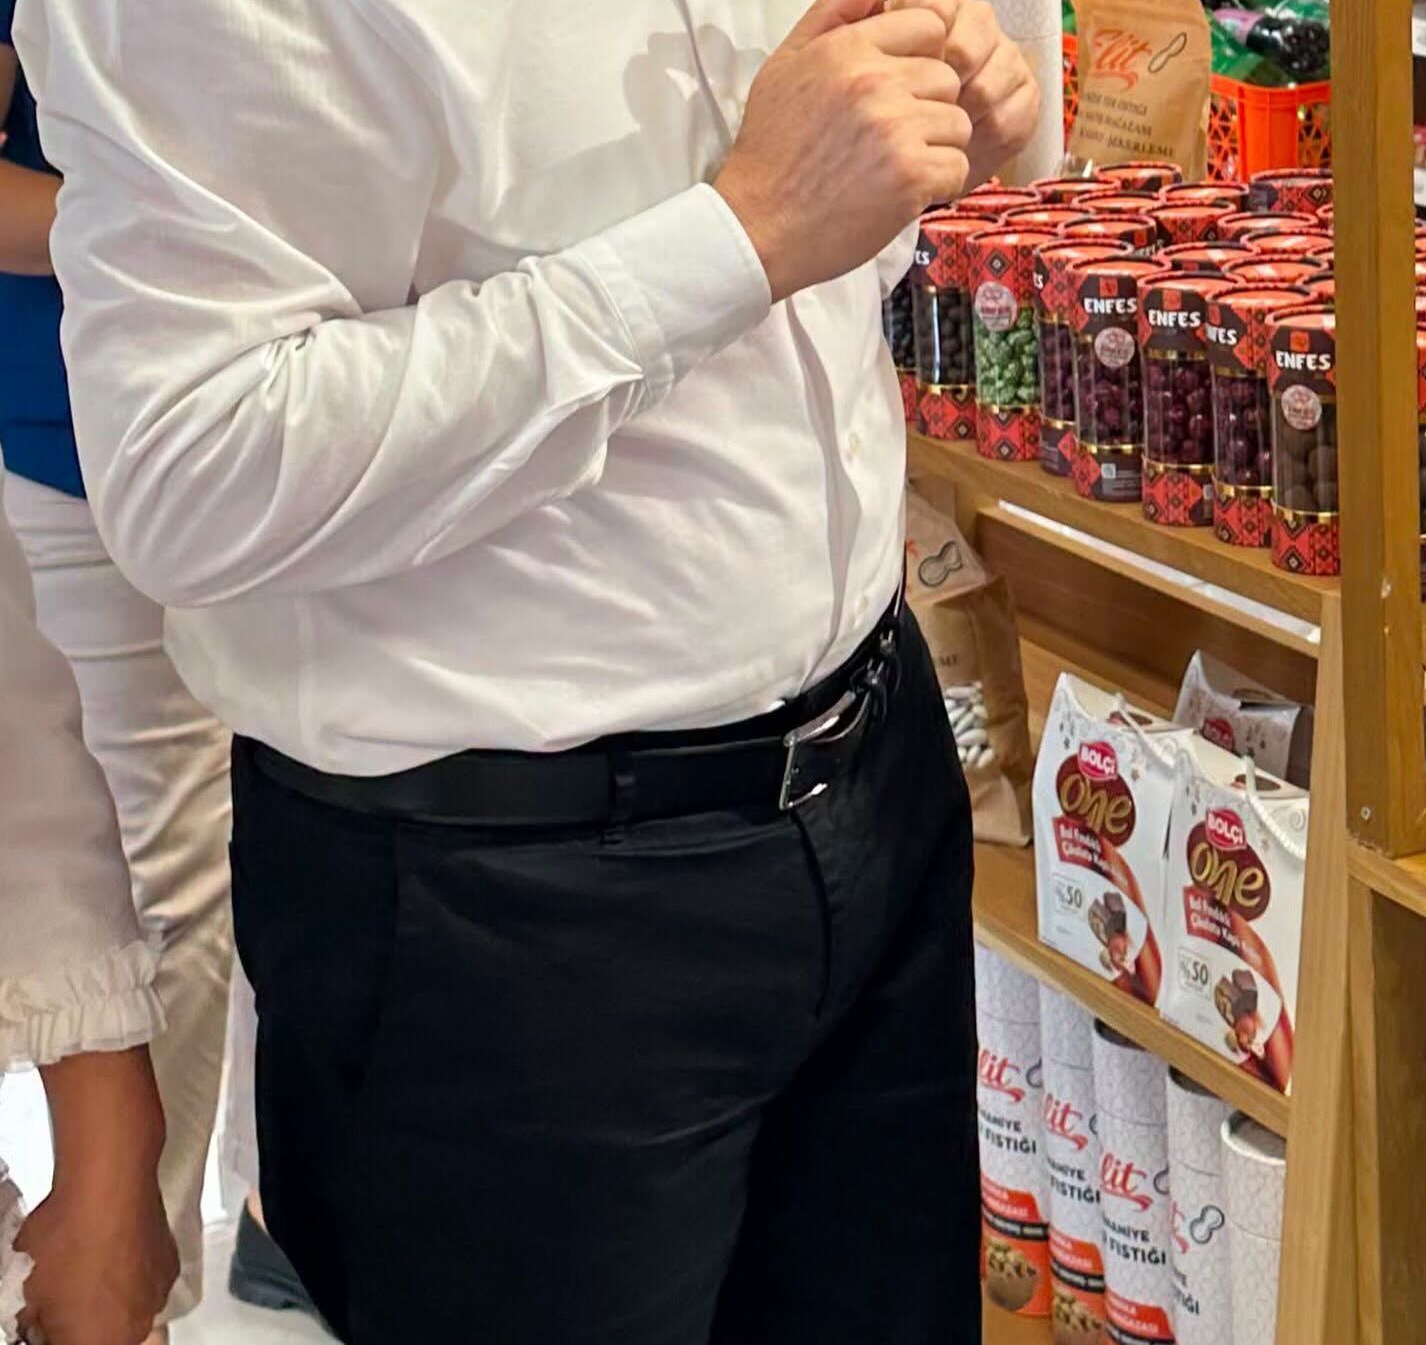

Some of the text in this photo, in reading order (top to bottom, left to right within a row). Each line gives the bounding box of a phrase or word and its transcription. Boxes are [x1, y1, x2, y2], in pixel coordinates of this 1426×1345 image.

[1083, 297, 1138, 315] ENFES
[1147, 310, 1201, 329] ENFES
[1275, 350, 1332, 372] ENFES
[979, 1049, 1025, 1103] lit
[1045, 1092, 1088, 1151] lit
[1100, 1151, 1154, 1211] lit
